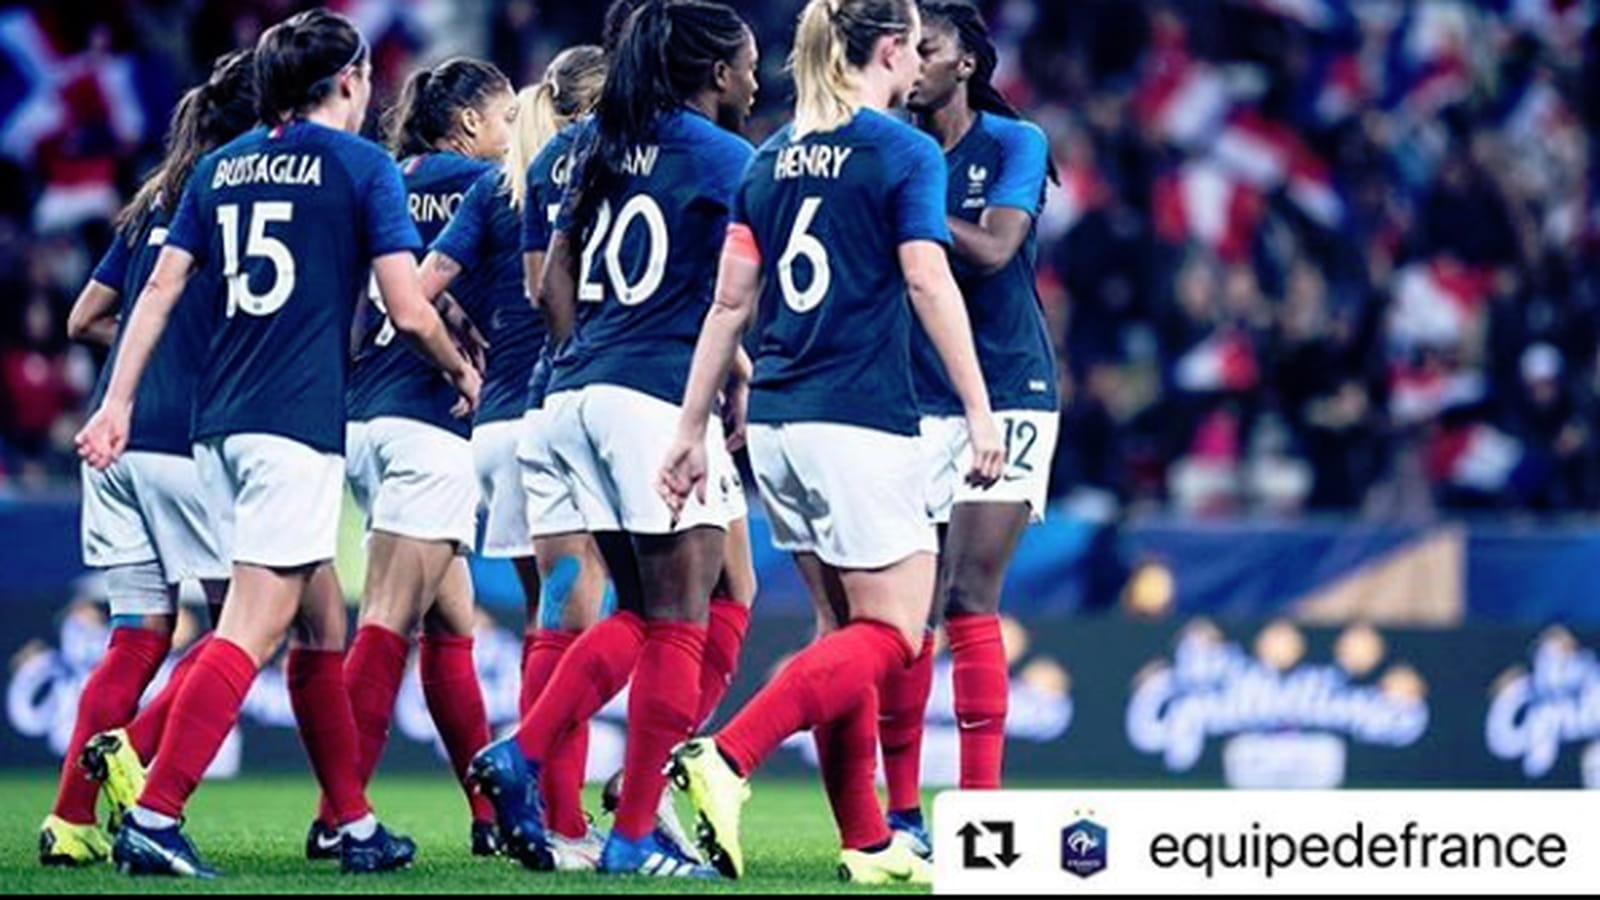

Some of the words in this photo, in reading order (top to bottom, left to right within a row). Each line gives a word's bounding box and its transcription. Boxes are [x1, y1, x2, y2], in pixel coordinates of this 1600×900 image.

[773, 143, 853, 181] HENRY
[407, 192, 465, 222] RINO
[215, 200, 297, 319] 15
[577, 193, 669, 307] 20
[776, 195, 832, 314] 6
[1002, 416, 1038, 472] 12
